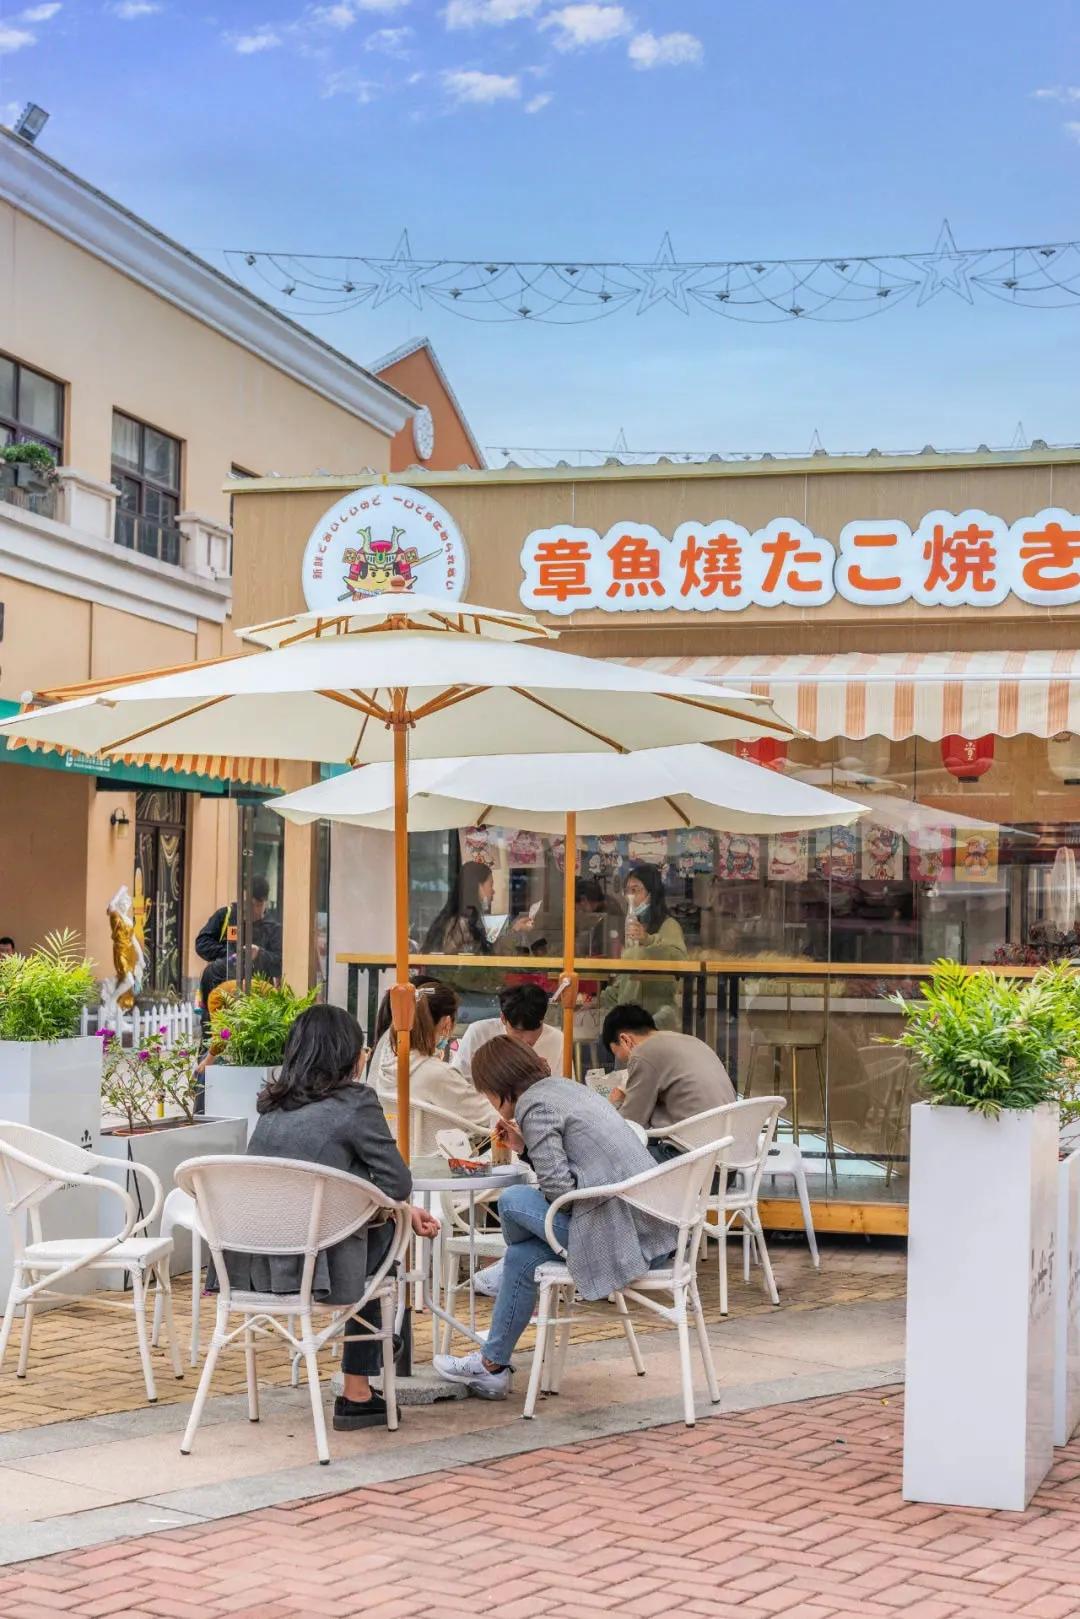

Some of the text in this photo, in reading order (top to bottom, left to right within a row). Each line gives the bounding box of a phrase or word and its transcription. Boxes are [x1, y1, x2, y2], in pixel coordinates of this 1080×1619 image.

[533, 522, 1080, 602] 章魚燒たこ焼き
